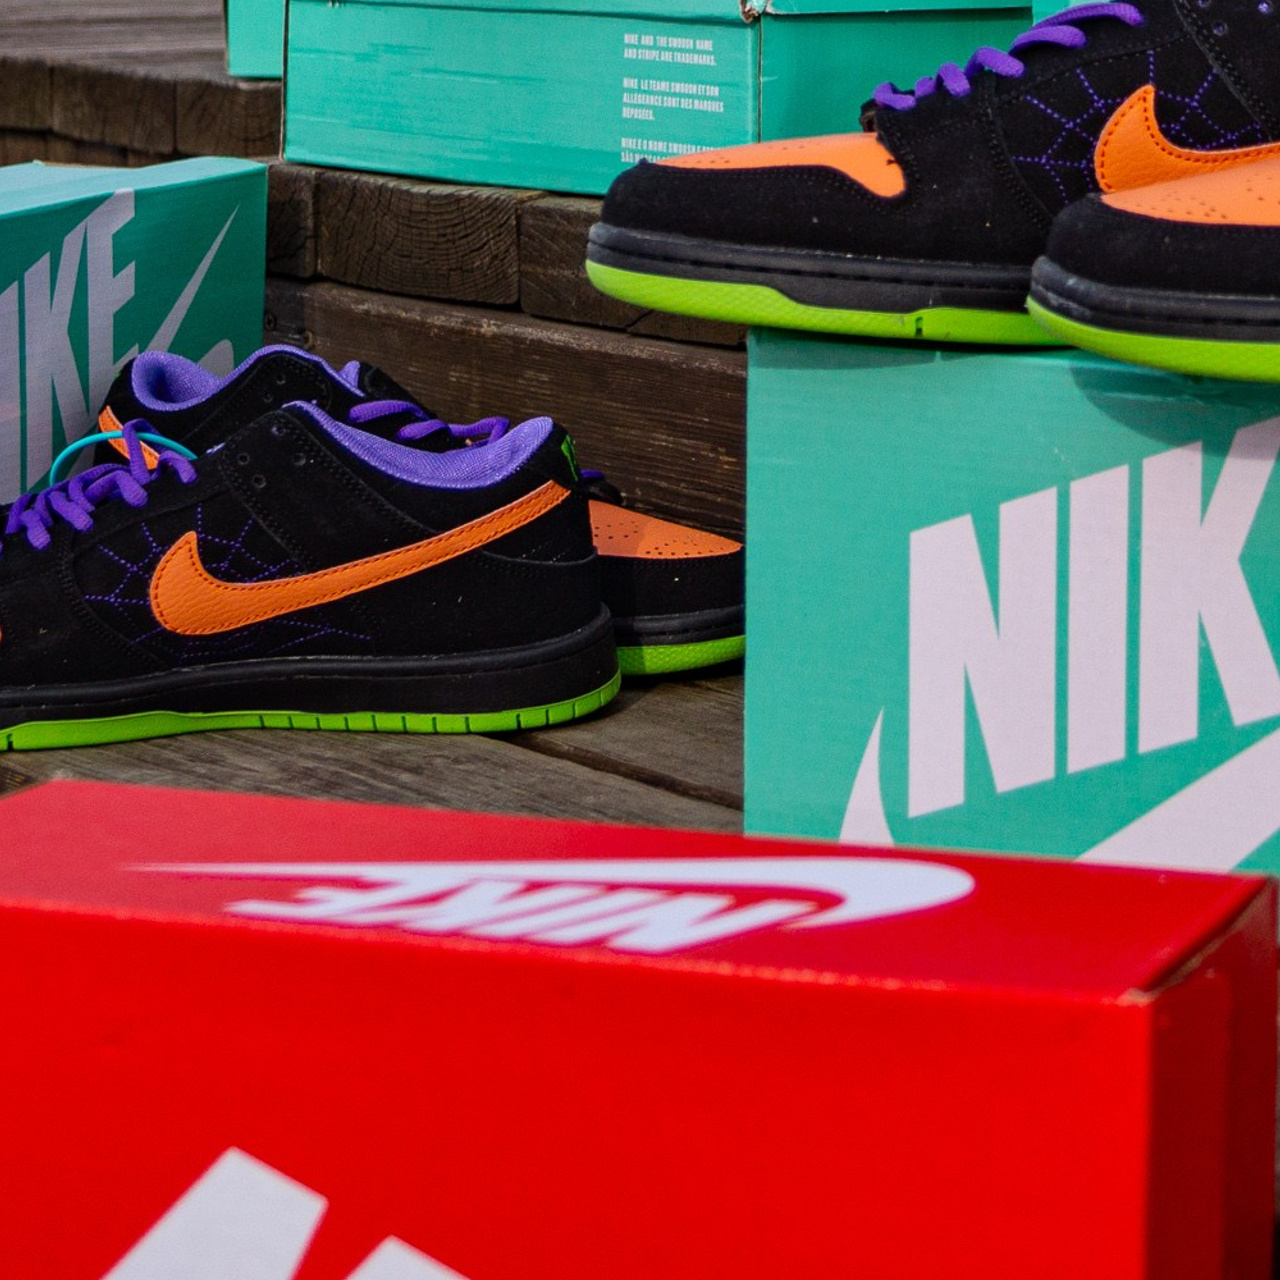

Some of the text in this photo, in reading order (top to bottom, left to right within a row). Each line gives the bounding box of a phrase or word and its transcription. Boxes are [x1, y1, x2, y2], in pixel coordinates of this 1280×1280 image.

[624, 33, 638, 45] NIKE
[641, 34, 654, 46] AND
[656, 36, 667, 47] THE
[668, 37, 694, 49] SWOOSH
[624, 48, 637, 59] AND
[638, 49, 659, 61] STRIPE
[660, 51, 673, 62] ARE
[623, 77, 638, 89] NIKE
[640, 79, 649, 90] LE
[621, 137, 637, 149] NIKE
[223, 875, 818, 953] NIKE
